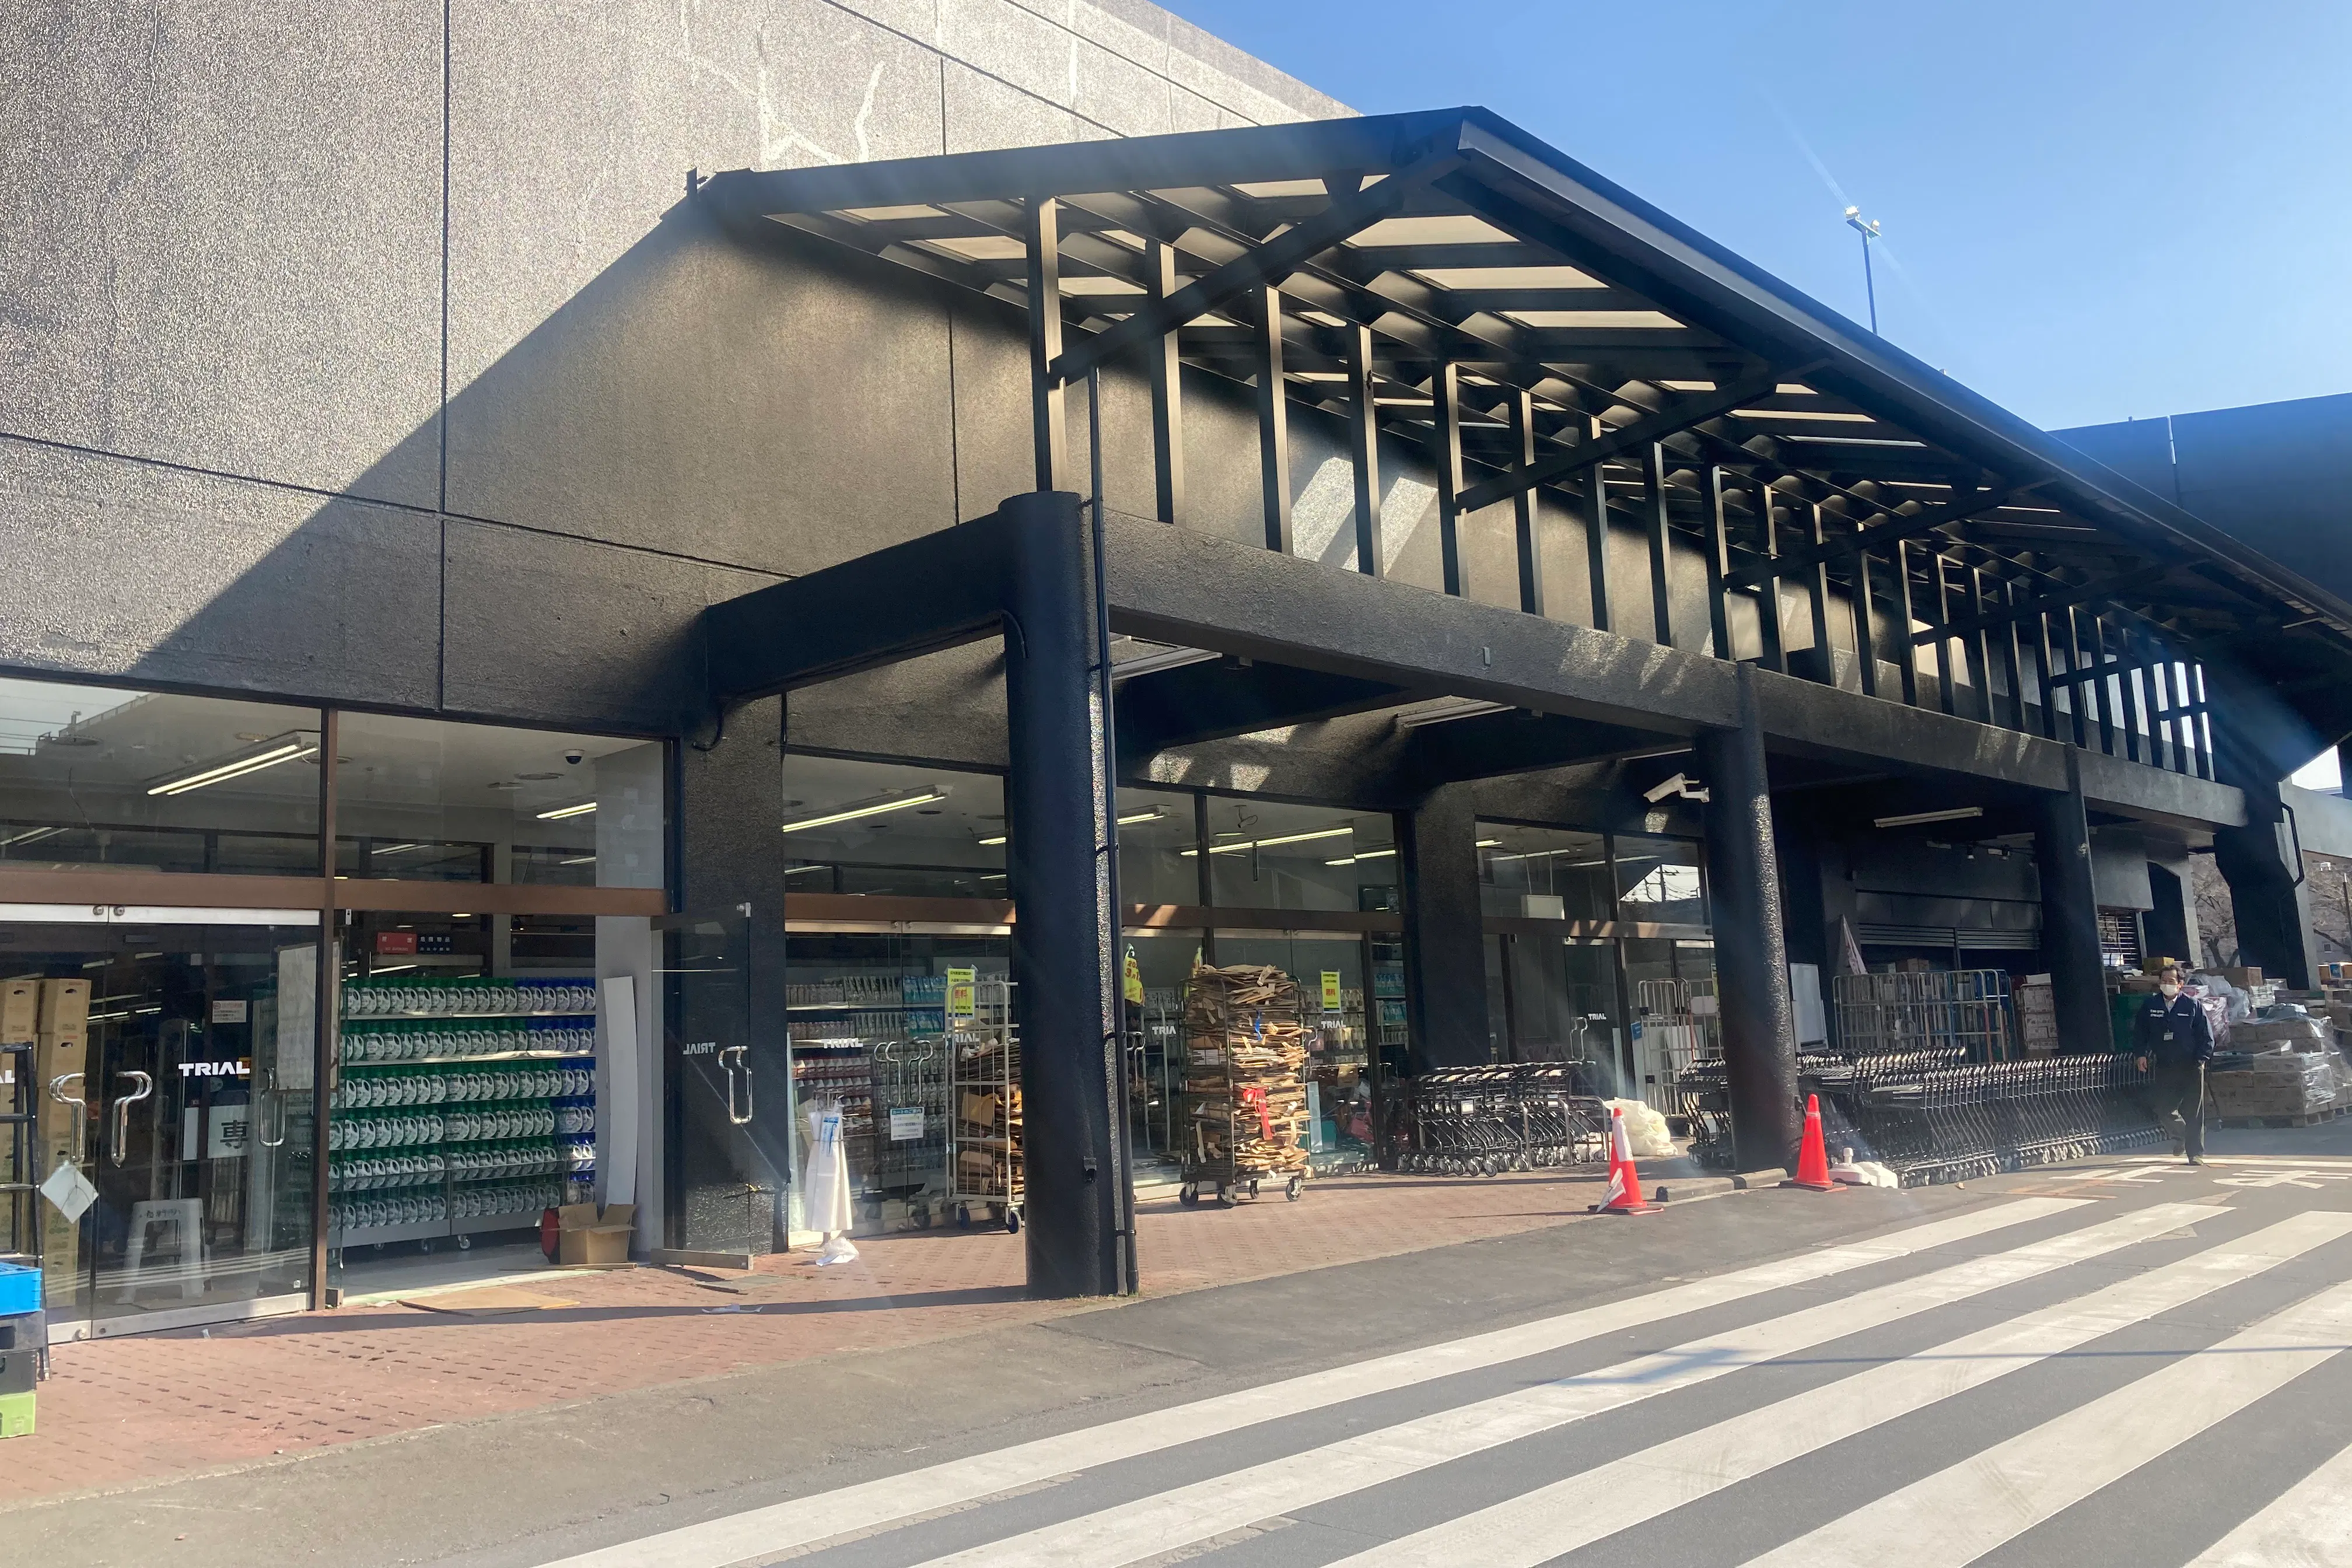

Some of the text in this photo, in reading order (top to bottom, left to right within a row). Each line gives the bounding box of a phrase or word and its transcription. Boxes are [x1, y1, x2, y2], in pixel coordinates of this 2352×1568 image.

[1321, 1020, 1346, 1028] TRIAL
[1152, 1026, 1177, 1035] TRIA
[821, 1038, 863, 1049] TRIAL
[178, 1062, 250, 1076] TRIAL
